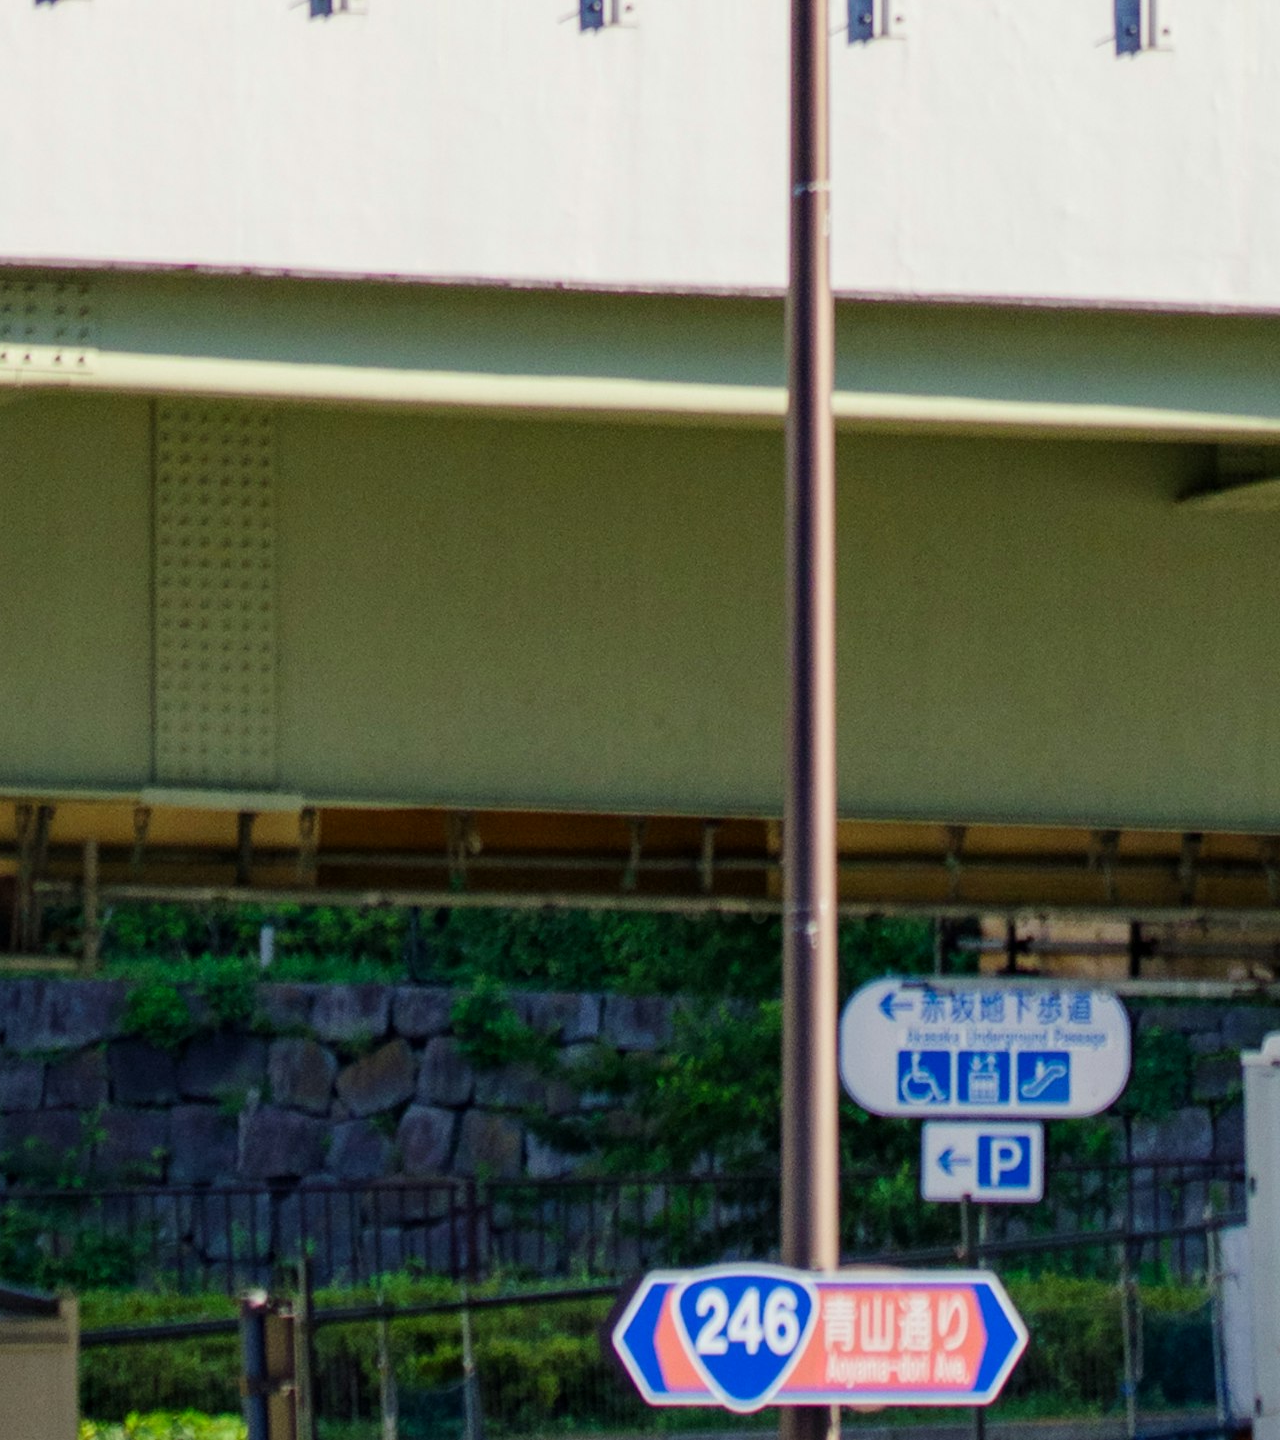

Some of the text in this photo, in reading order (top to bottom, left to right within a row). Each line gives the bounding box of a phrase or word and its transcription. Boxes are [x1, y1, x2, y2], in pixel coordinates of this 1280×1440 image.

[920, 989, 1092, 1025] 赤坂地下歩道
[990, 1139, 1022, 1187] P
[695, 1286, 799, 1356] 246
[822, 1292, 970, 1353] 青山通り
[825, 1353, 930, 1389] Aoyama-dori
